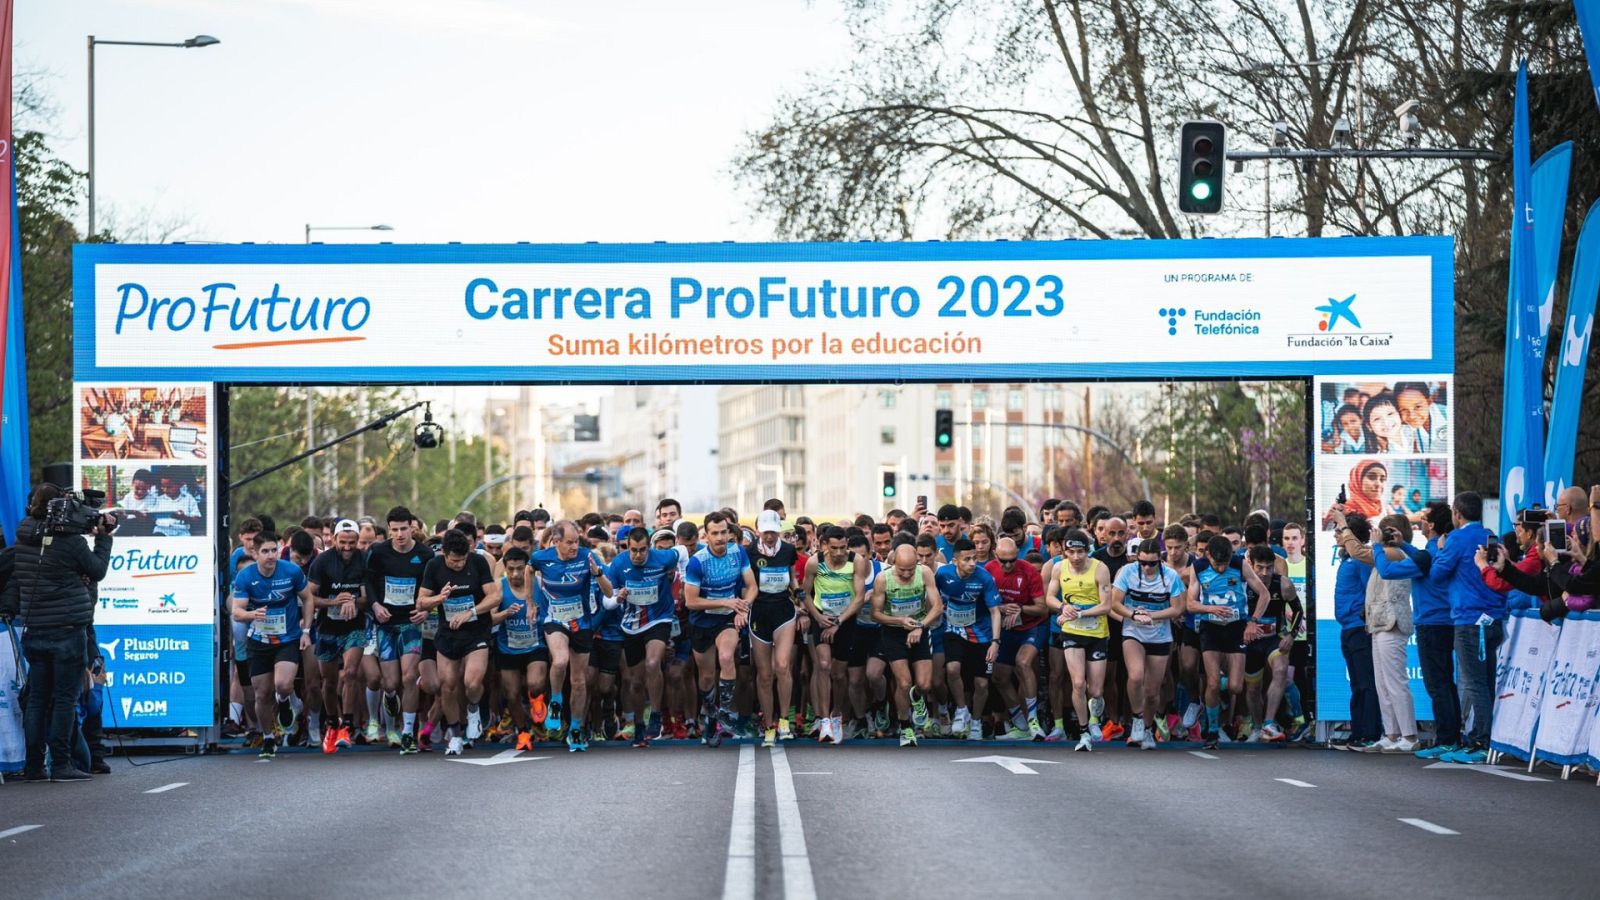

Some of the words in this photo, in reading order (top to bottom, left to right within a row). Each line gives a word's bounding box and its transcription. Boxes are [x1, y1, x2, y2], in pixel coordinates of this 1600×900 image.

[1164, 274, 1179, 283] UN
[1181, 273, 1237, 282] PROGRAMA
[464, 277, 652, 320] Carrera
[670, 276, 921, 319] ProFuturo
[937, 274, 1065, 317] 2023
[115, 282, 371, 335] ProFuturo
[1194, 308, 1261, 321] Fundación
[1194, 322, 1260, 336] Telefónica
[547, 333, 620, 356] Suma
[628, 332, 764, 356] kilómetros
[771, 338, 814, 360] por
[821, 332, 843, 355] la
[851, 331, 982, 355] educación
[1287, 336, 1343, 347] Fundación
[124, 638, 190, 650] PlusUltra
[124, 651, 159, 661] Seguros
[123, 672, 186, 685] MADRID
[132, 700, 168, 713] ADM
